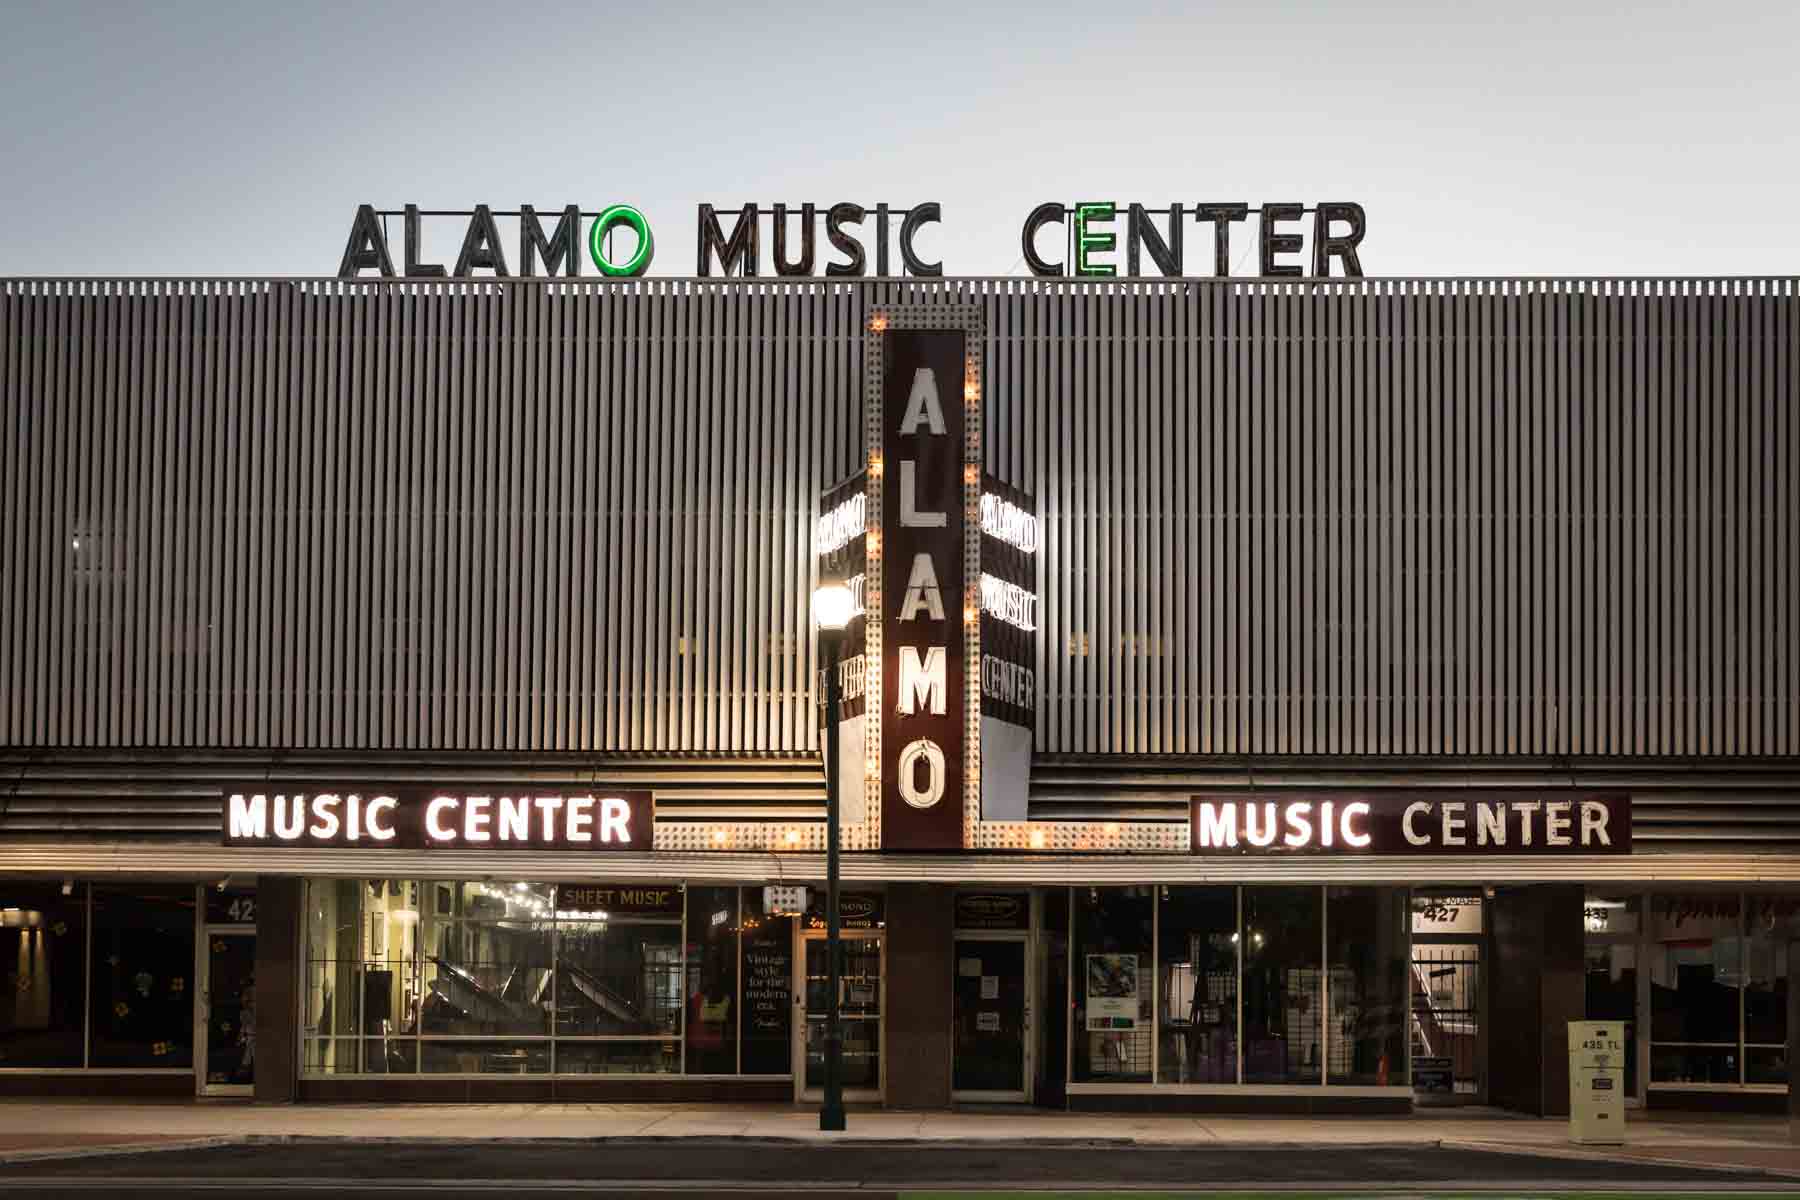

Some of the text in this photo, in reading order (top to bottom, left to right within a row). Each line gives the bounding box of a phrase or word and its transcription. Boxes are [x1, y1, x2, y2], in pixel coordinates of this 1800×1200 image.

[337, 201, 1367, 278] ALAMO MUSIC CENTER
[898, 366, 947, 810] ALAMO
[978, 570, 1037, 632] MUSIC
[981, 653, 1035, 711] CENTER
[229, 794, 632, 843] MUSIC CENTER
[1198, 801, 1612, 848] MUSIC CENTER
[227, 899, 256, 921] 42
[566, 889, 671, 905] SHEET MUSIC
[1423, 906, 1460, 922] 427
[1583, 1040, 1602, 1049] 435
